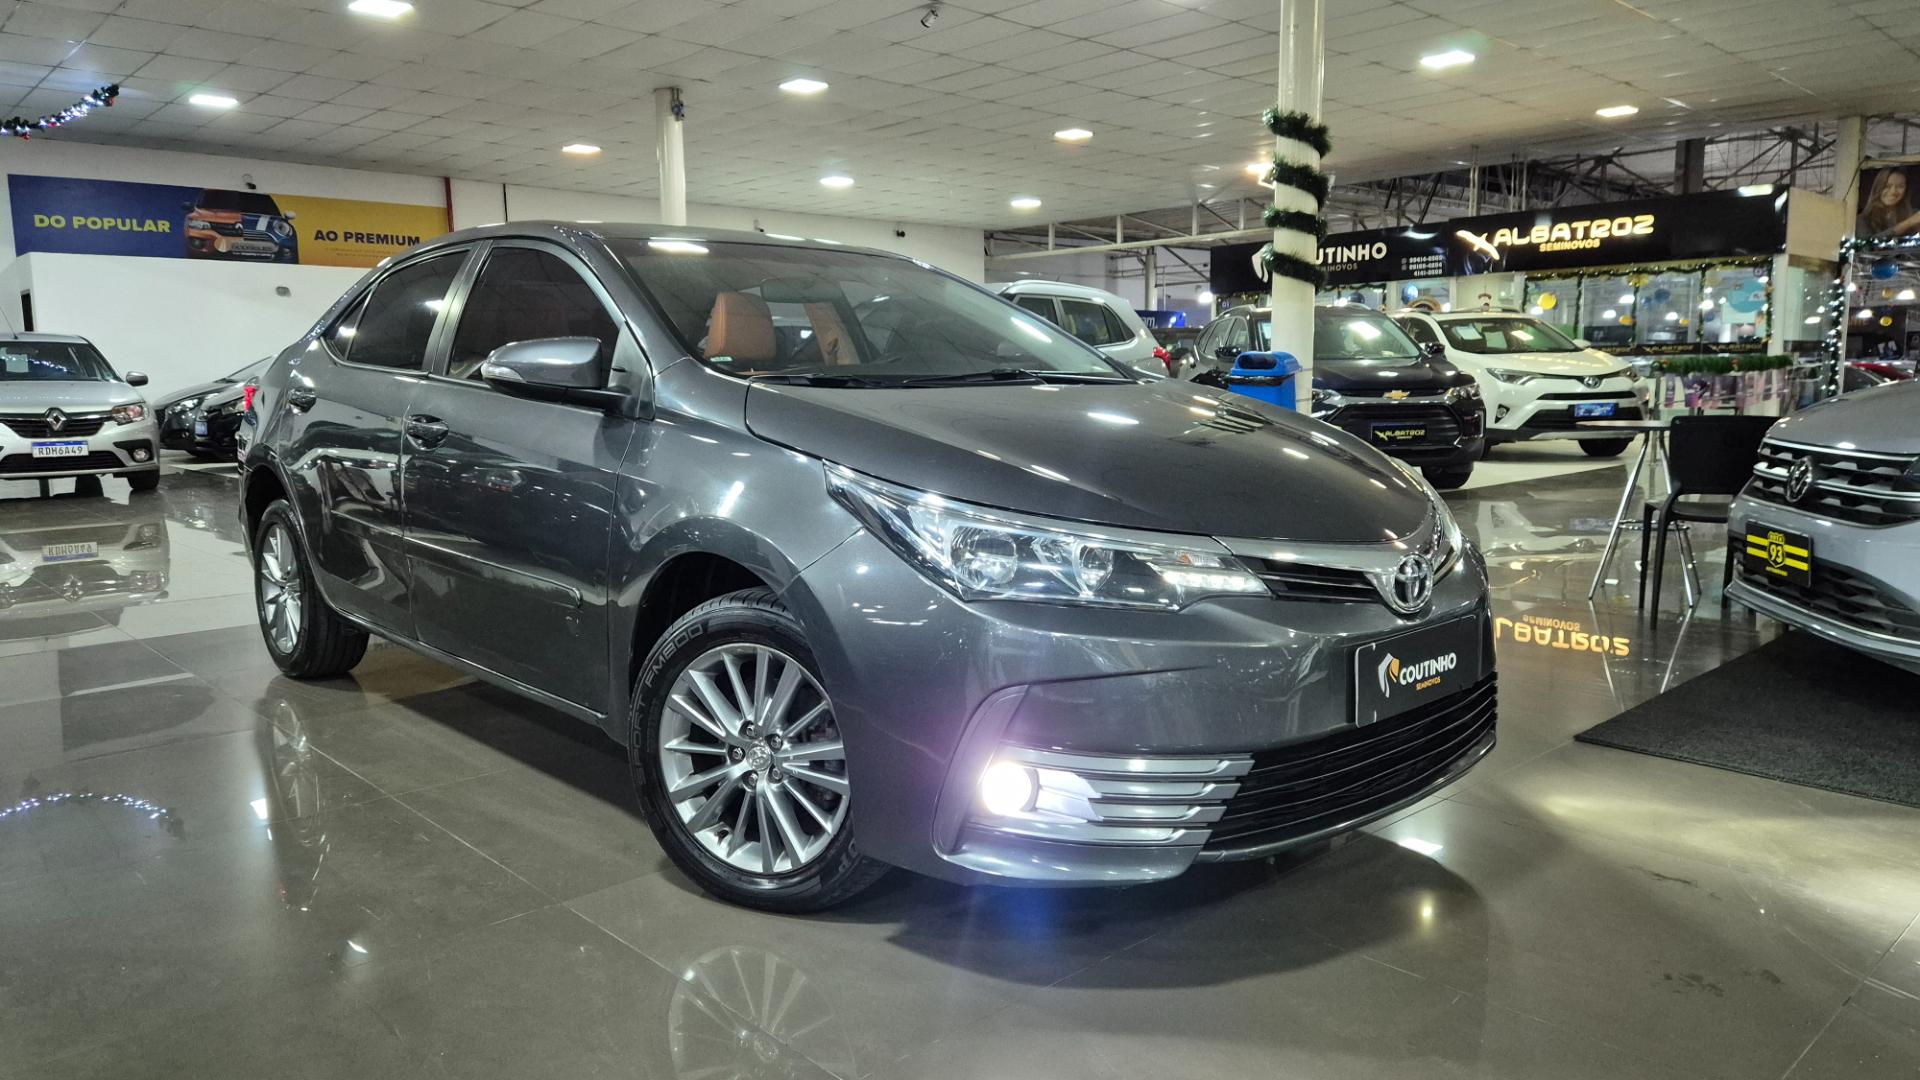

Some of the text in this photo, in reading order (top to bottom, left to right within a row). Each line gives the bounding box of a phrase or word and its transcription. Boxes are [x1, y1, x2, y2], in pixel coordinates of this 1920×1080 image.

[34, 215, 170, 233] DO POPULAR
[1494, 214, 1655, 247] ALBATROZ
[314, 230, 420, 246] AO PREMIUM
[1539, 238, 1601, 253] SEMINOVOS
[1314, 242, 1387, 265] UTINHO
[37, 446, 83, 456] RDH6A49
[1769, 544, 1784, 563] 93
[1400, 652, 1457, 686] COUTINHO
